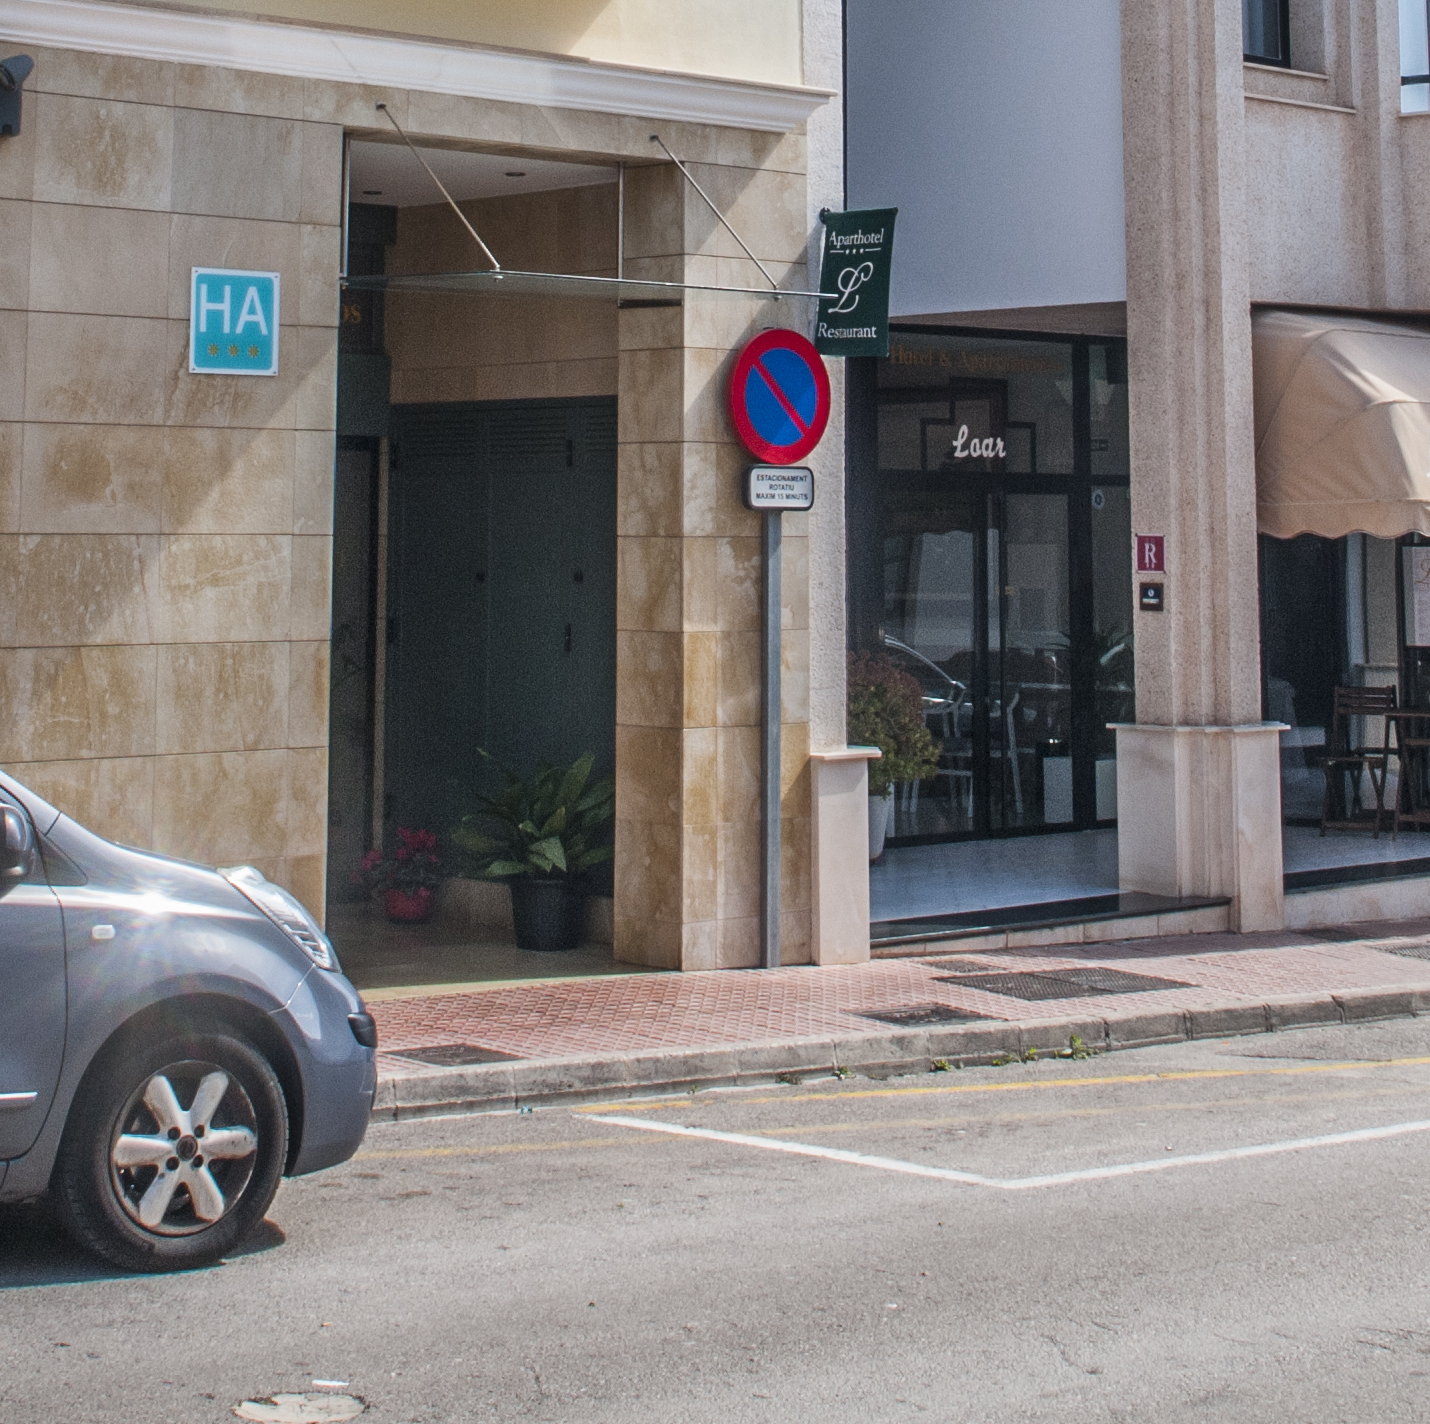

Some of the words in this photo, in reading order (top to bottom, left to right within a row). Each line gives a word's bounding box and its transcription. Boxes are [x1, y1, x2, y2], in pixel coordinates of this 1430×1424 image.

[829, 228, 885, 249] Aparthotel
[199, 283, 268, 336] HA
[817, 322, 878, 339] Restaurant
[952, 425, 1007, 458] Loar
[756, 474, 808, 483] ESTACIONAMENT
[769, 483, 795, 491] ROTATIU
[785, 493, 809, 501] MINUTS
[1144, 542, 1157, 564] R
